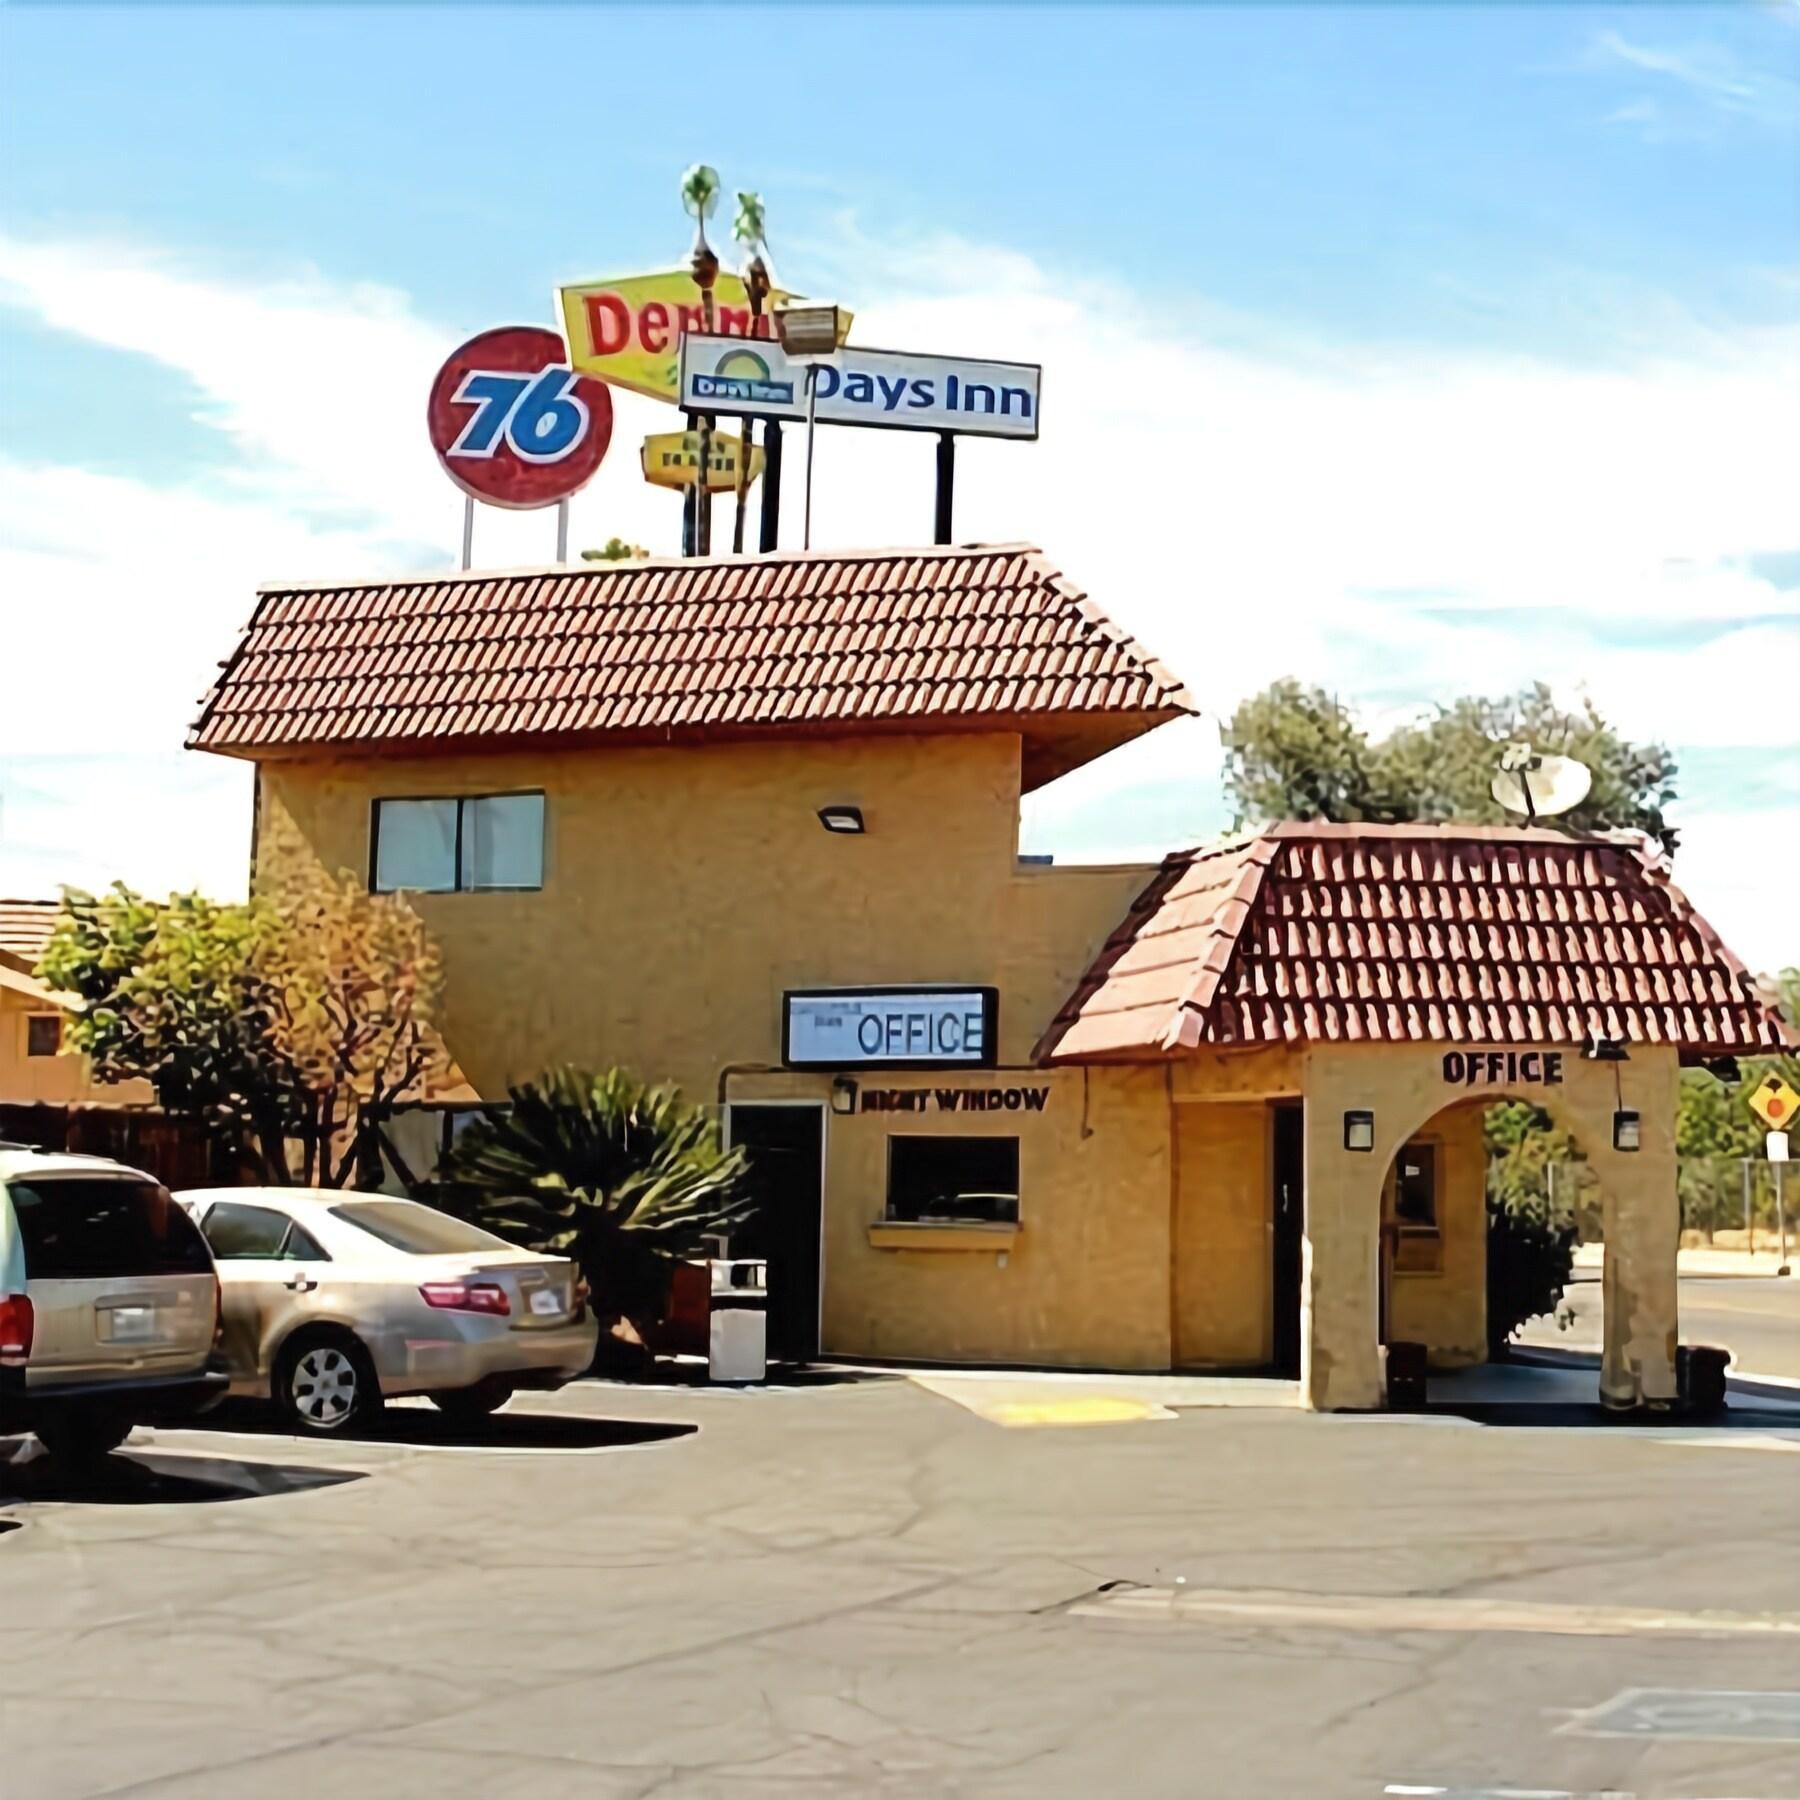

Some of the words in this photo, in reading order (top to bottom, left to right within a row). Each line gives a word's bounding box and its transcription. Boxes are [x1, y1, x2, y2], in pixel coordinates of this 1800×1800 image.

[804, 363, 935, 412] Days
[946, 374, 1032, 418] Inn
[447, 364, 590, 464] 76
[858, 1012, 982, 1055] OFFICE
[1442, 1051, 1563, 1087] OFFICE
[934, 1086, 1051, 1112] WINDOW
